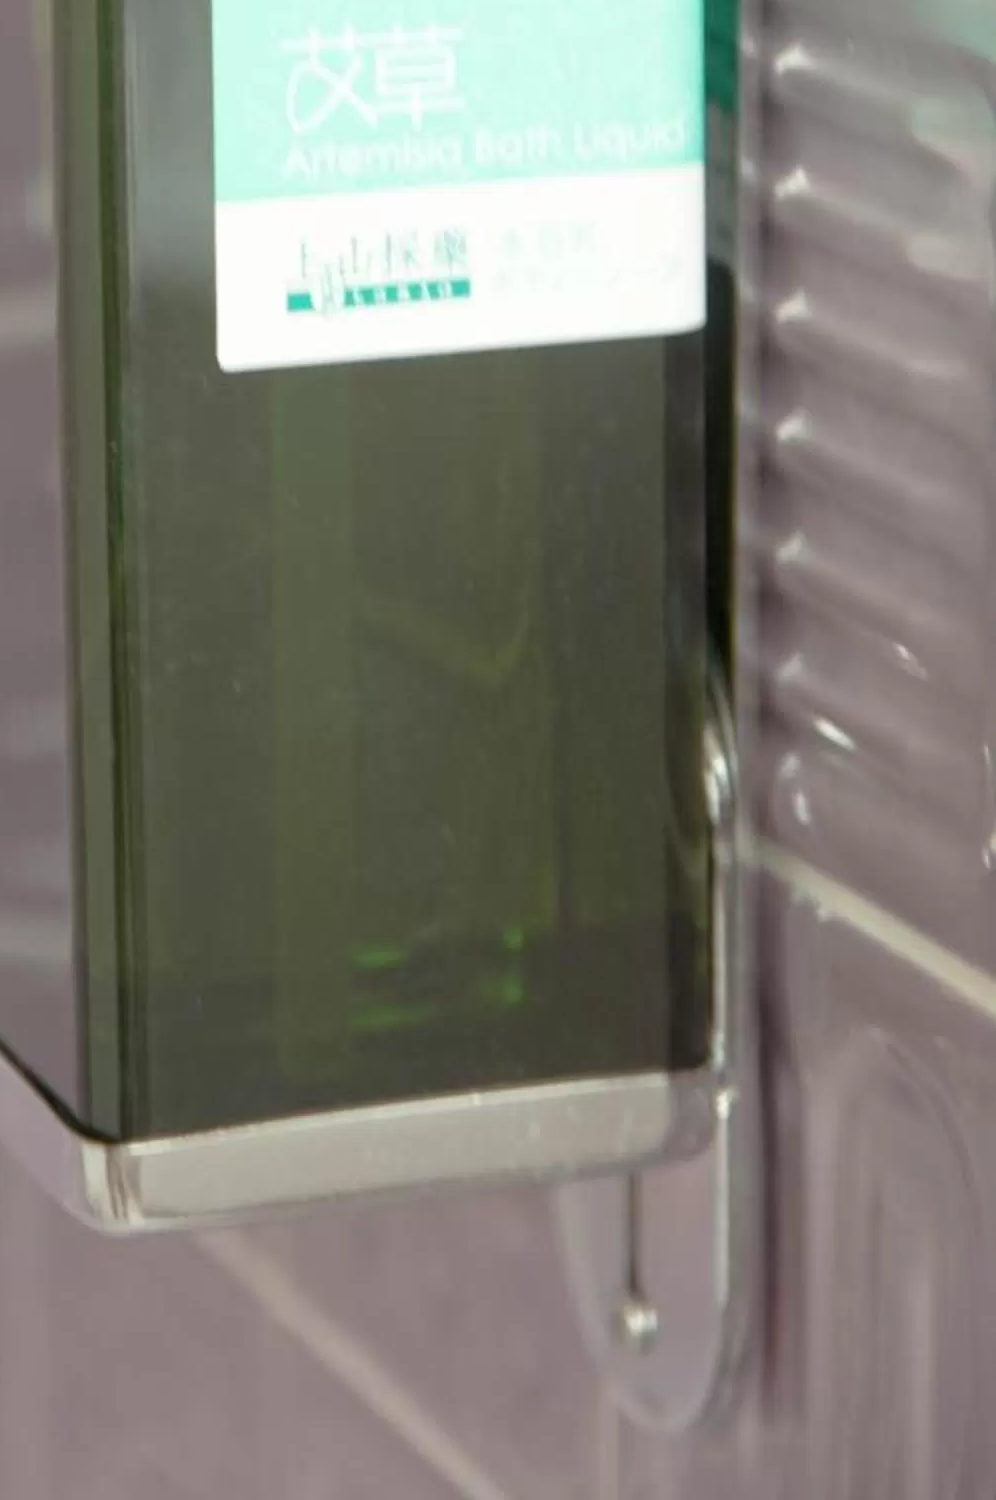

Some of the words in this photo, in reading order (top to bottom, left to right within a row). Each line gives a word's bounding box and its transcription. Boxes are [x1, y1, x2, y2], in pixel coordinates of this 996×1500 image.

[279, 24, 467, 133] 艾草
[282, 133, 463, 180] Artemisia
[474, 124, 562, 165] Bath
[572, 116, 686, 166] Liquid
